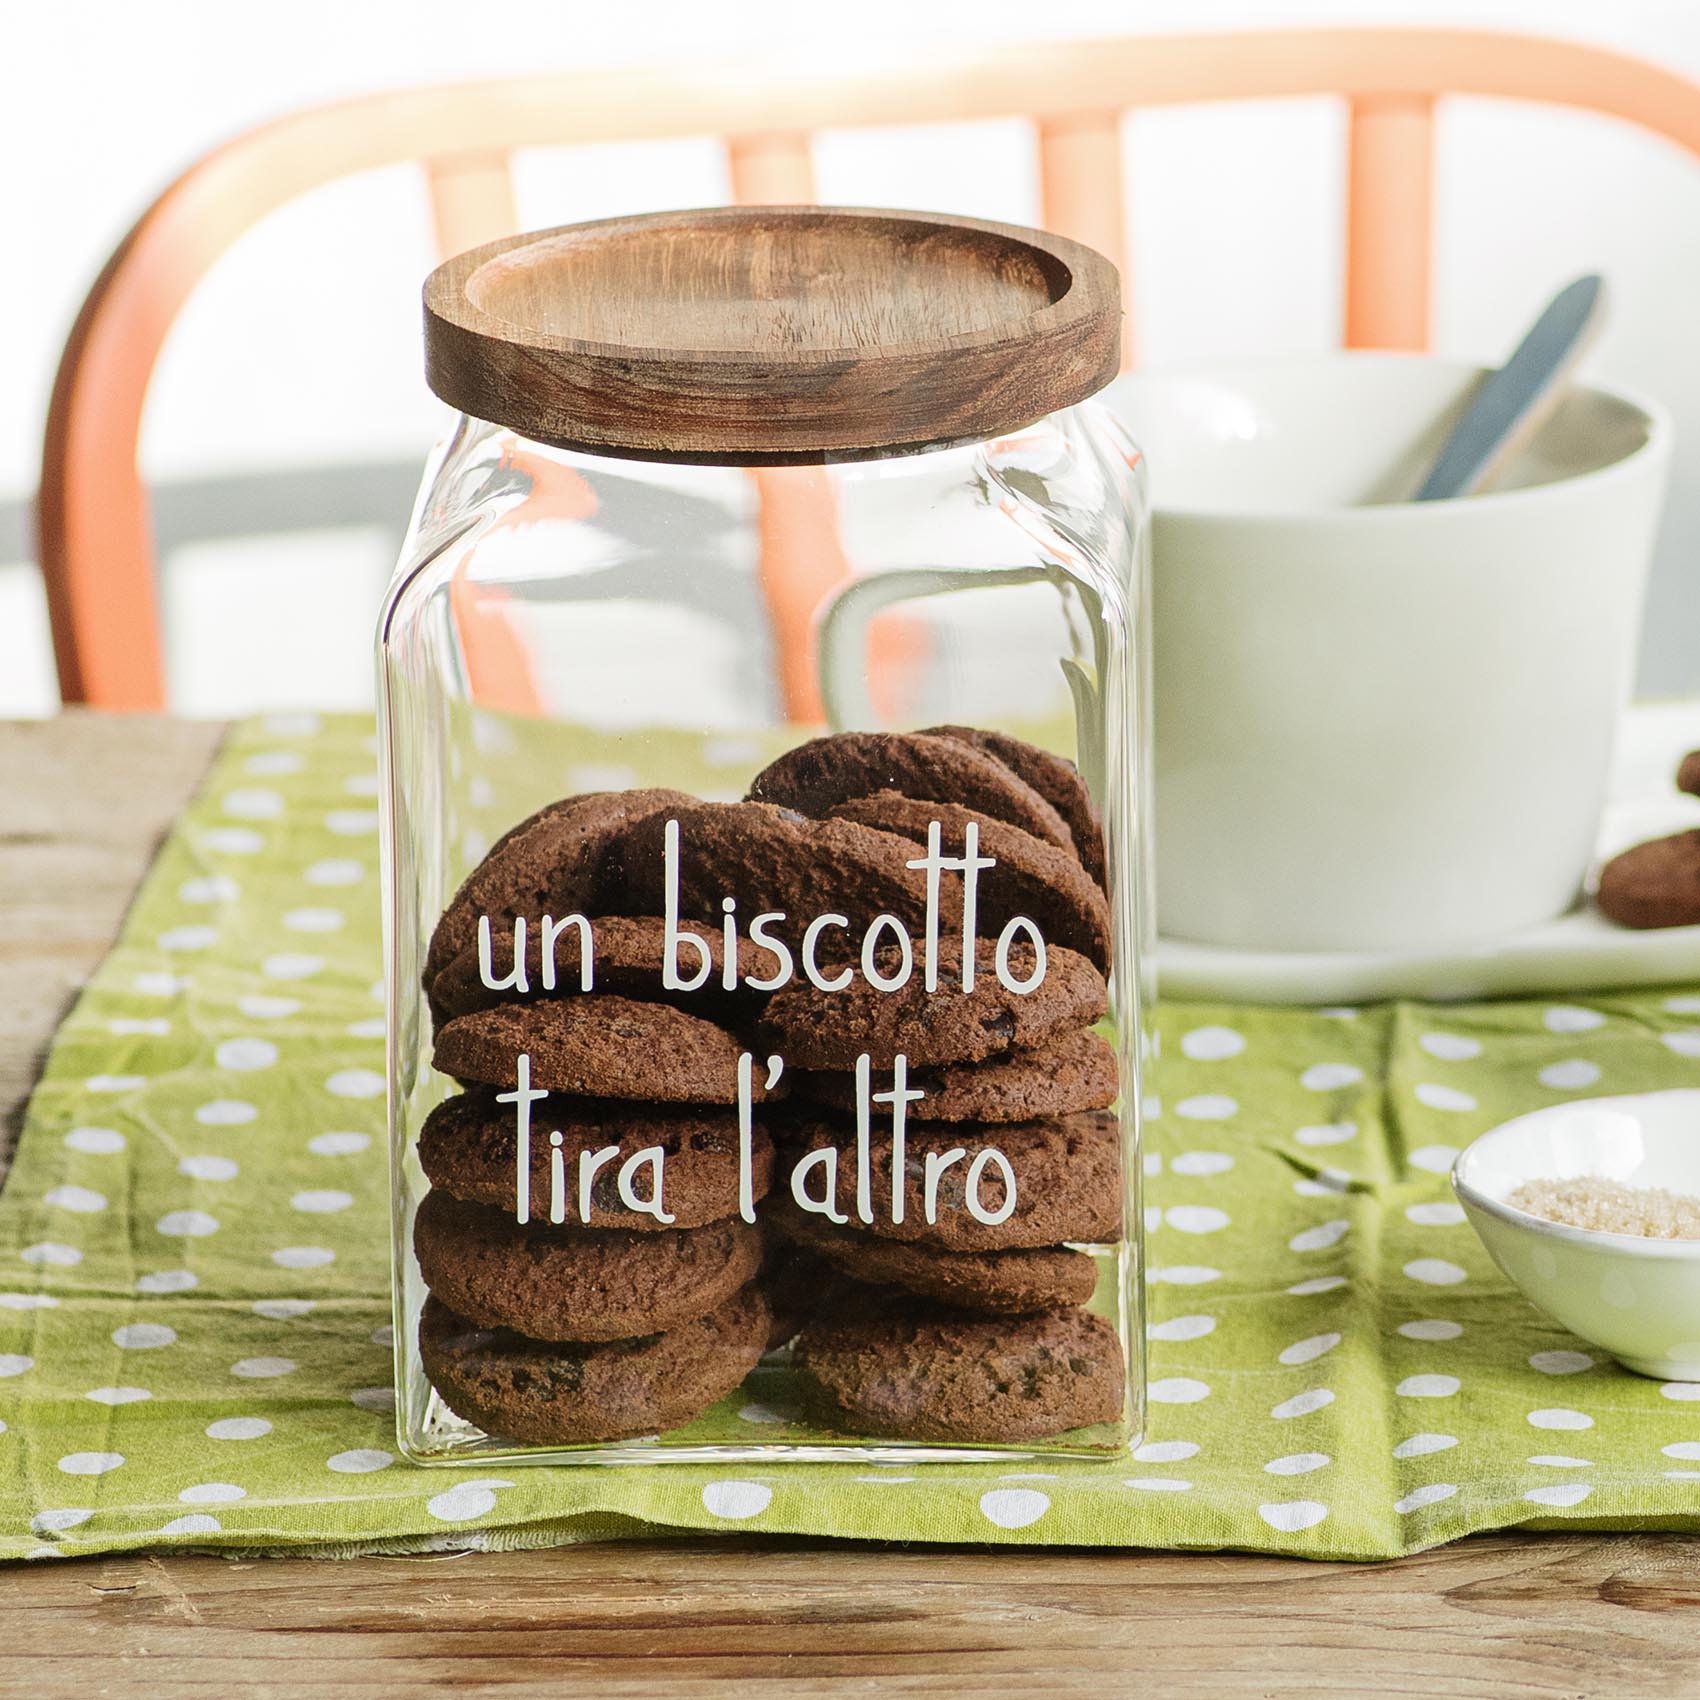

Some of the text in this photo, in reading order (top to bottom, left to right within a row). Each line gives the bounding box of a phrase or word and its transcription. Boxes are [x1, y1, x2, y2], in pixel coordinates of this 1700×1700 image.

[478, 819, 1047, 994] un biscotto
[495, 1052, 1018, 1225] tira l'altro
